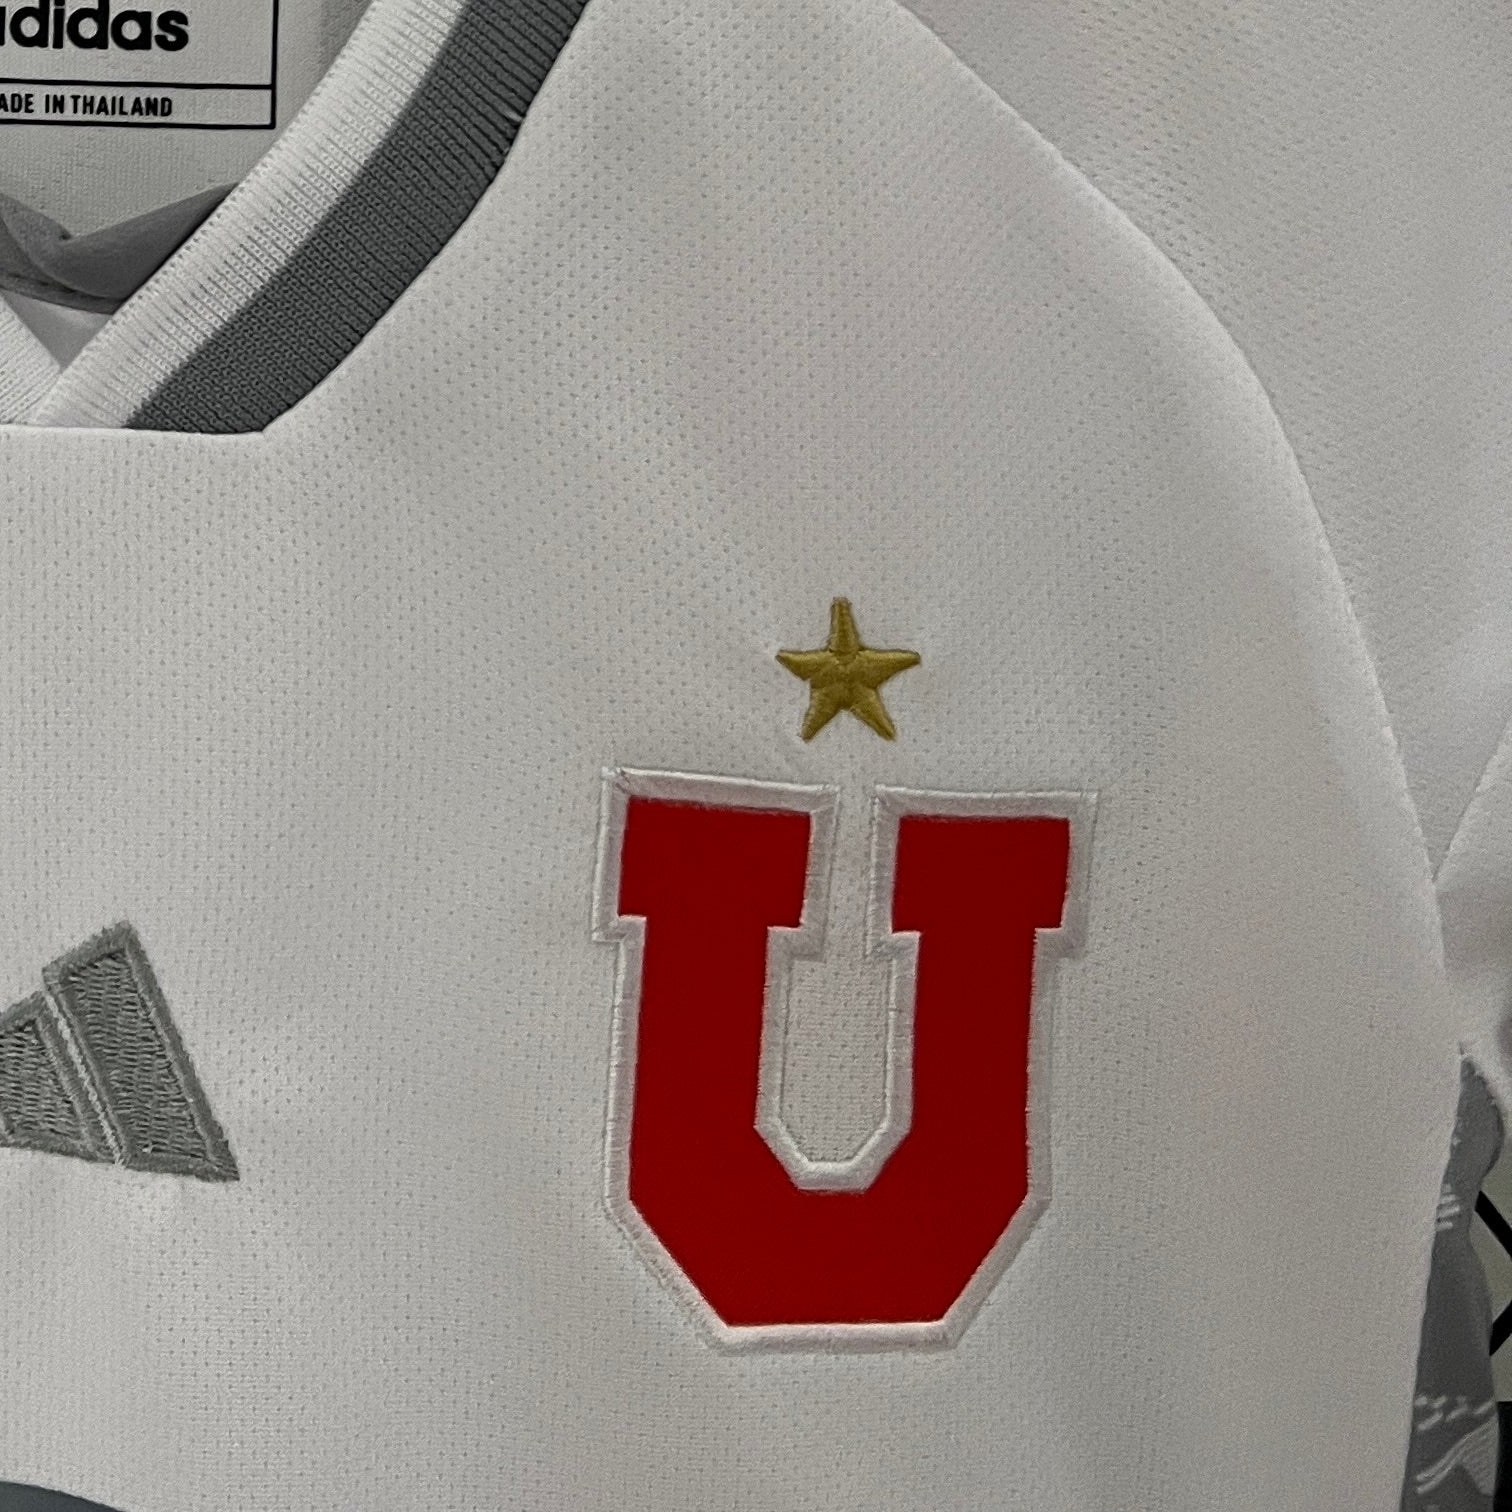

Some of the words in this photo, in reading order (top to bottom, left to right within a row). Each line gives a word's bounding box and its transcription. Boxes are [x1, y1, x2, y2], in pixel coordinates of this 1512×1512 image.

[45, 94, 65, 114] IN
[71, 95, 172, 117] THAILAND
[616, 793, 1073, 1330] U
